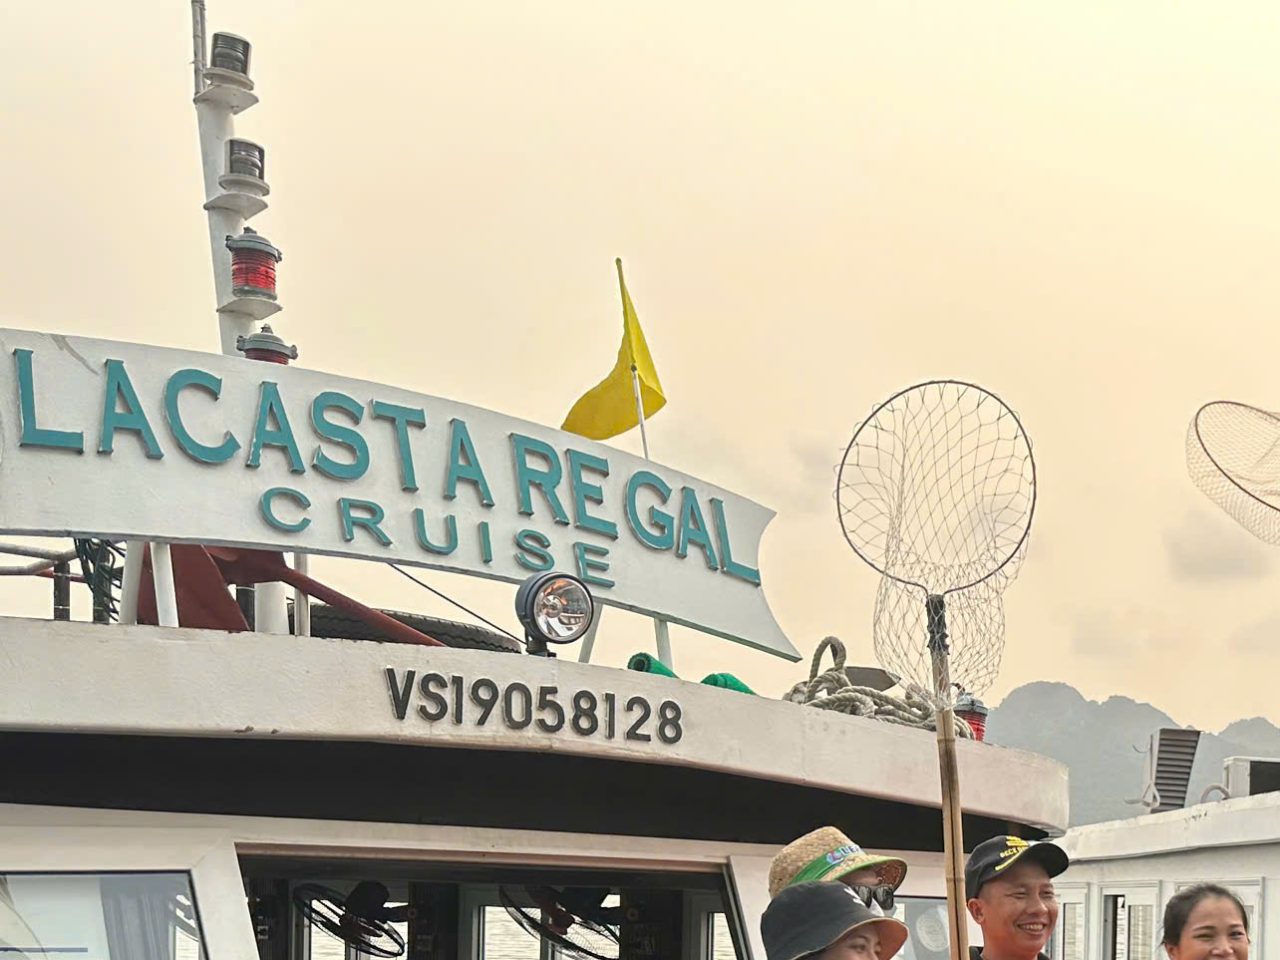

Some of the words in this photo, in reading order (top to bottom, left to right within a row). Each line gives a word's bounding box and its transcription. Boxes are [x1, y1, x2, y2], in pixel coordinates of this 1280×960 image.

[259, 486, 616, 589] CRUISE
[508, 432, 761, 587] REGAL
[386, 665, 683, 745] VS19058128
